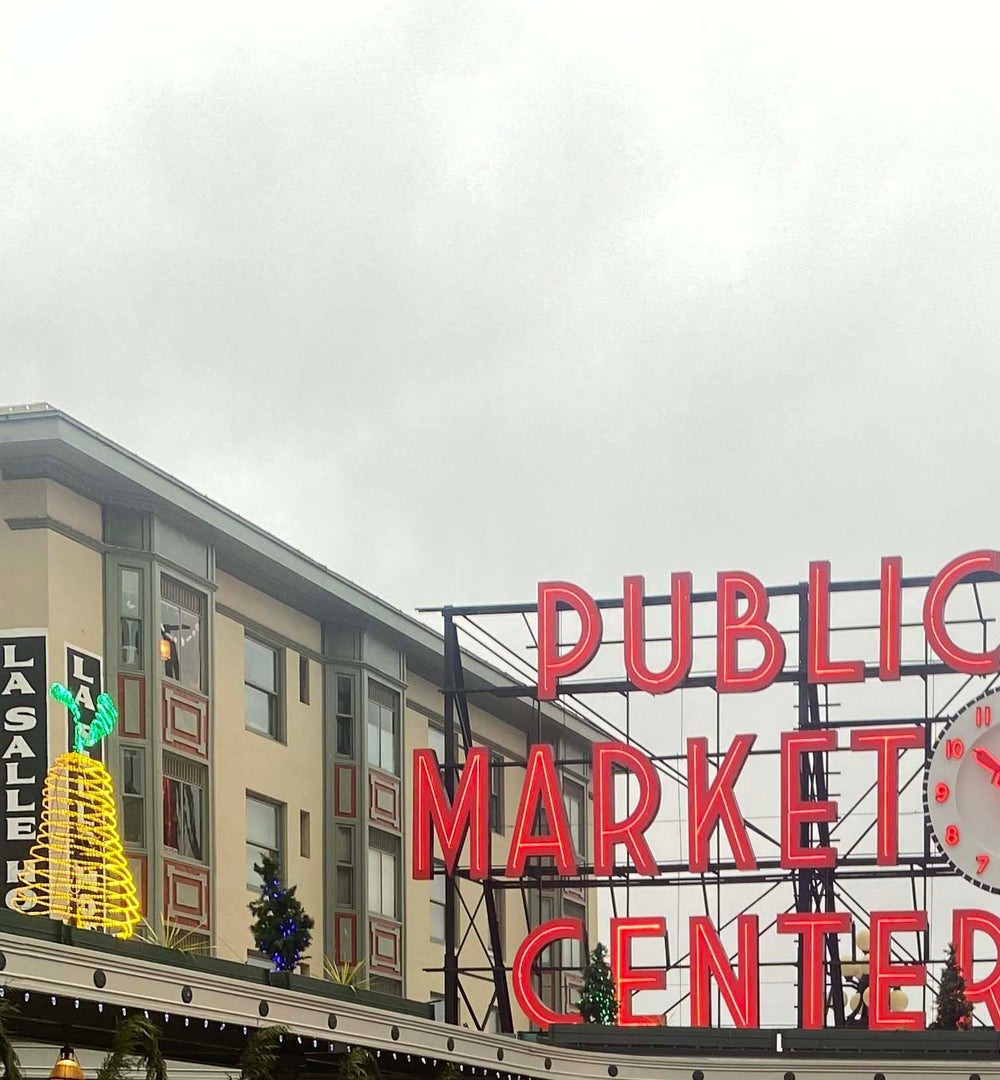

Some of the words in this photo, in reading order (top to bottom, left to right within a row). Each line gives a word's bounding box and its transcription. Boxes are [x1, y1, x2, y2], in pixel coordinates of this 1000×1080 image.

[974, 706, 992, 728] 11
[945, 737, 965, 760] 10
[412, 726, 926, 881] MARKET
[934, 782, 950, 804] 9
[945, 824, 960, 846] 8
[975, 854, 990, 875] 7
